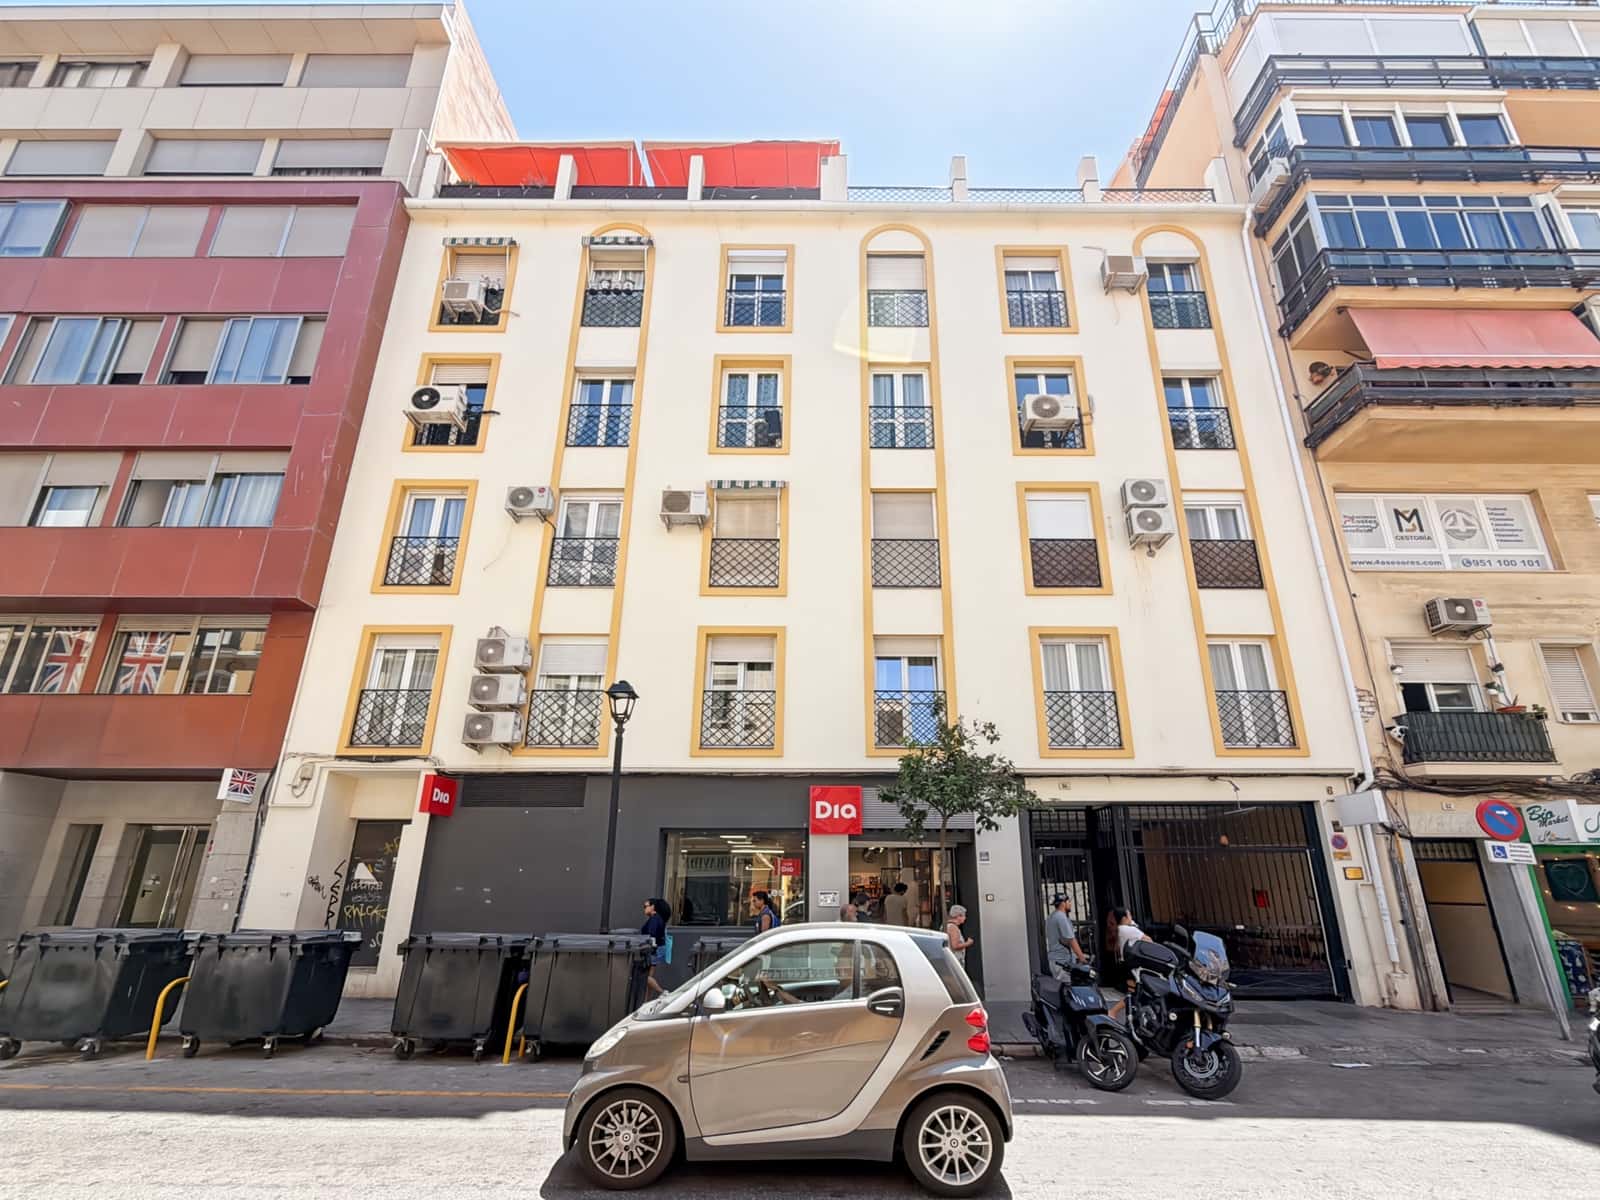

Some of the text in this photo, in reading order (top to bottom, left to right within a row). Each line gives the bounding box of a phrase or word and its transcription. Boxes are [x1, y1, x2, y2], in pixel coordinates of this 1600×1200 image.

[1472, 559, 1541, 567] 951 100 101
[815, 800, 857, 819] Dia
[1526, 805, 1554, 821] Bio
[1538, 815, 1569, 828] Market
